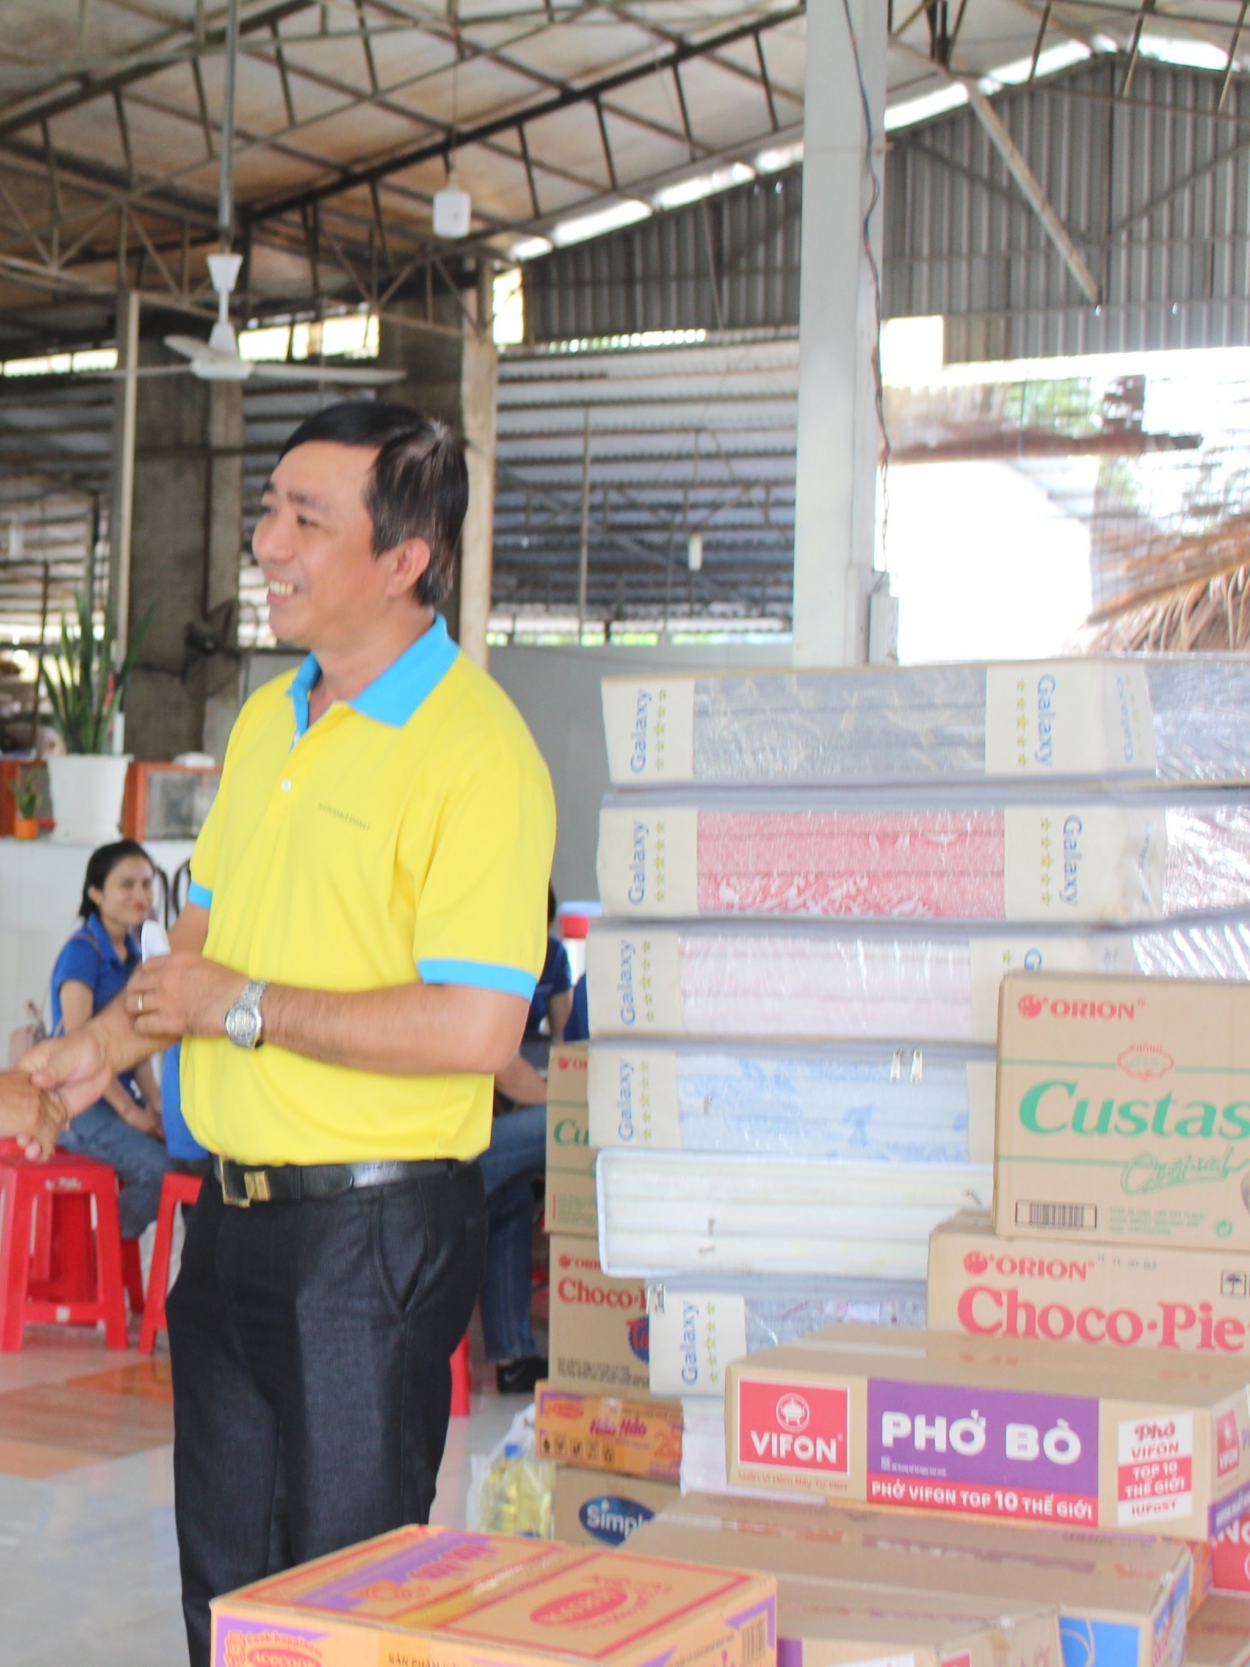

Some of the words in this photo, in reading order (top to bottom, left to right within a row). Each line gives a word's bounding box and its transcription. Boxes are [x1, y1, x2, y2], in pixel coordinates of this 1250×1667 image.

[630, 688, 652, 774] Galaxy
[1035, 674, 1056, 768] Galaxy
[628, 819, 649, 905] Galaxy
[1059, 814, 1083, 908] Galaxy
[618, 939, 637, 1027] Galaxy
[1050, 999, 1136, 1021] ORION
[617, 1057, 635, 1142] Galaxy
[995, 1254, 1088, 1281] ORION
[680, 1300, 699, 1386] Galaxy
[750, 1430, 838, 1465] VIFON
[881, 1409, 987, 1457] PHỞ
[1005, 1418, 1082, 1466] BÒ
[1132, 1441, 1179, 1460] VIFON
[1133, 1463, 1160, 1481] TOP
[1163, 1460, 1178, 1477] 10
[908, 1484, 956, 1506] VIFON
[959, 1490, 992, 1509] TOP
[994, 1490, 1019, 1512] 10
